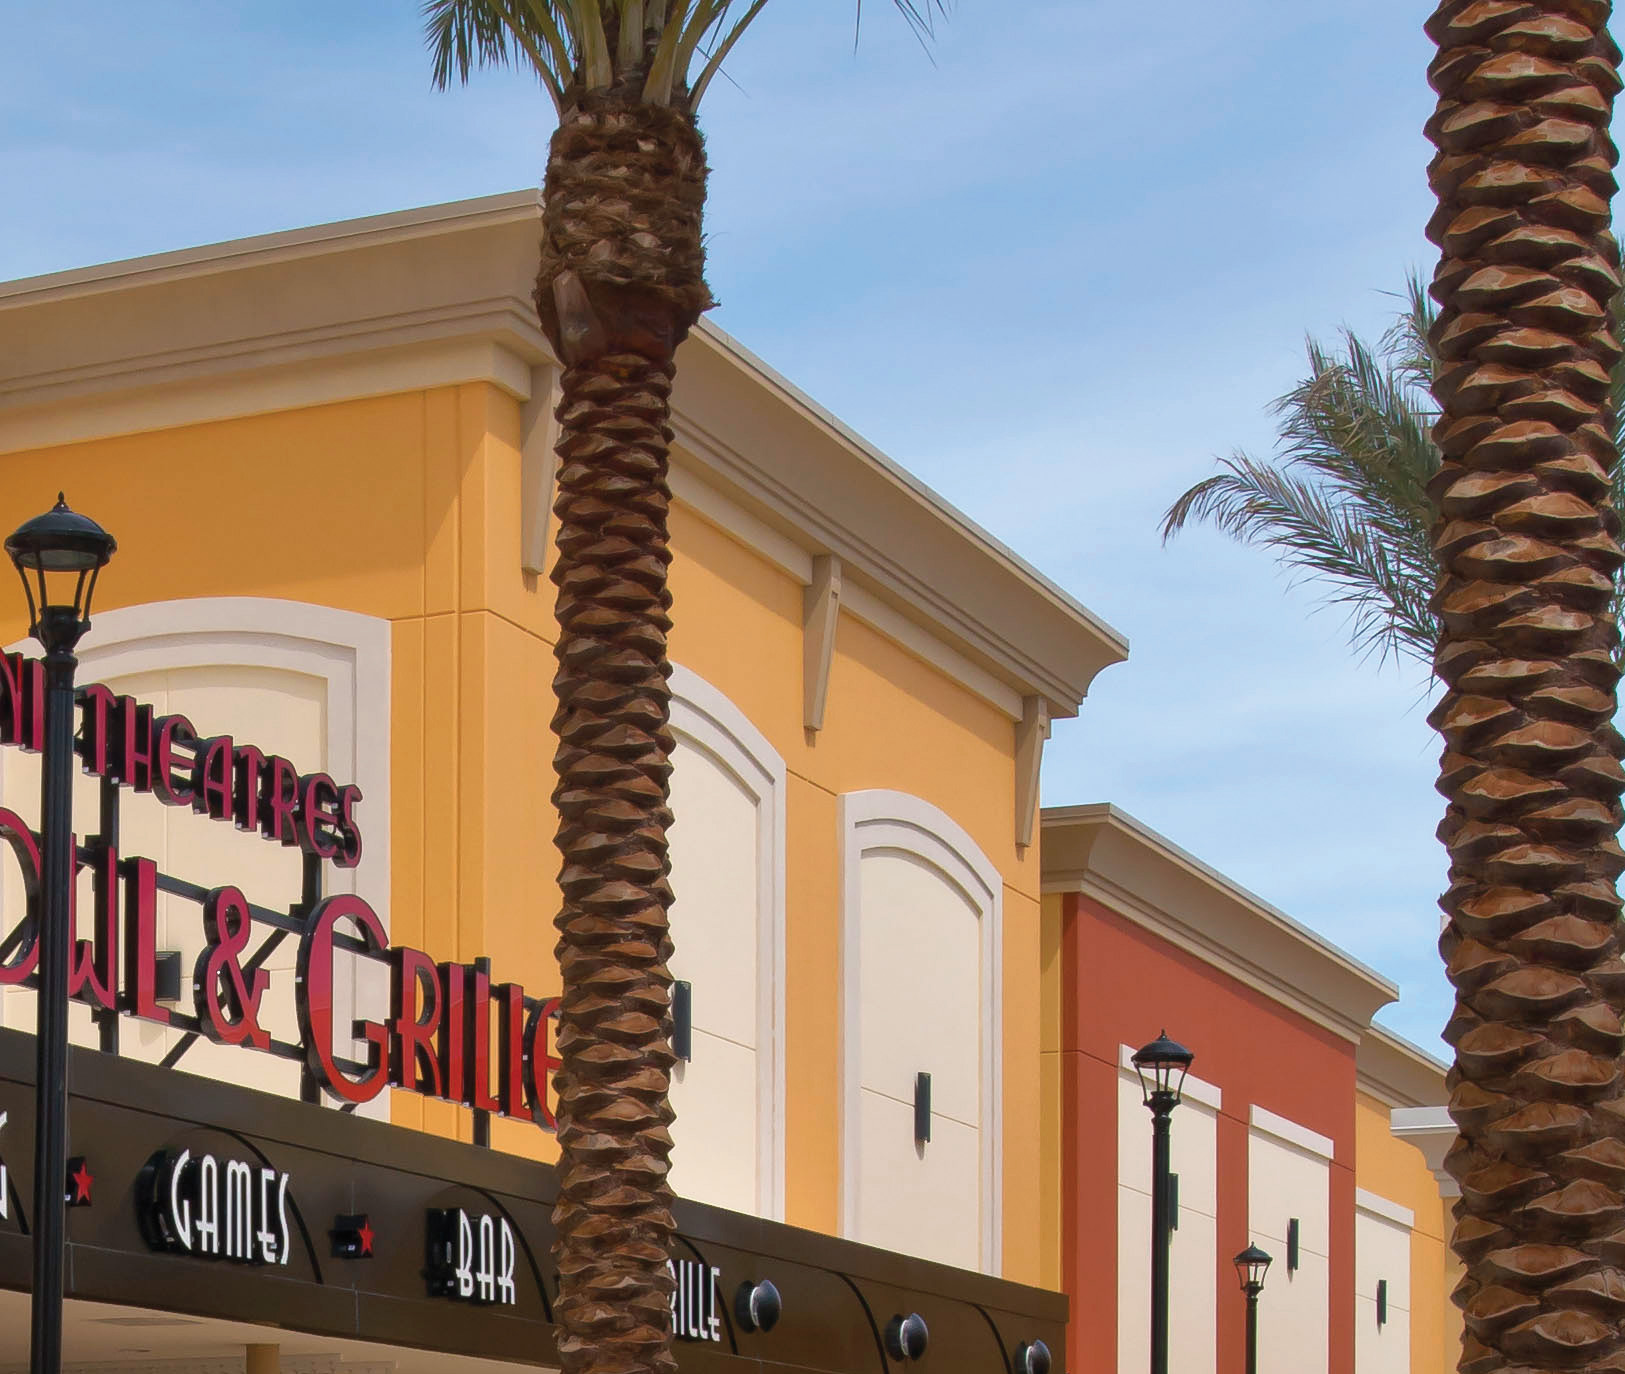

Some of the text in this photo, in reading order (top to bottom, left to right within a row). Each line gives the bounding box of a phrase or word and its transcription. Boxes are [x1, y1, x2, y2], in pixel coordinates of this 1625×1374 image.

[78, 683, 362, 867] THEATRES
[208, 886, 270, 1050] &
[170, 1148, 290, 1265] GAMES
[456, 1209, 516, 1305] BAR
